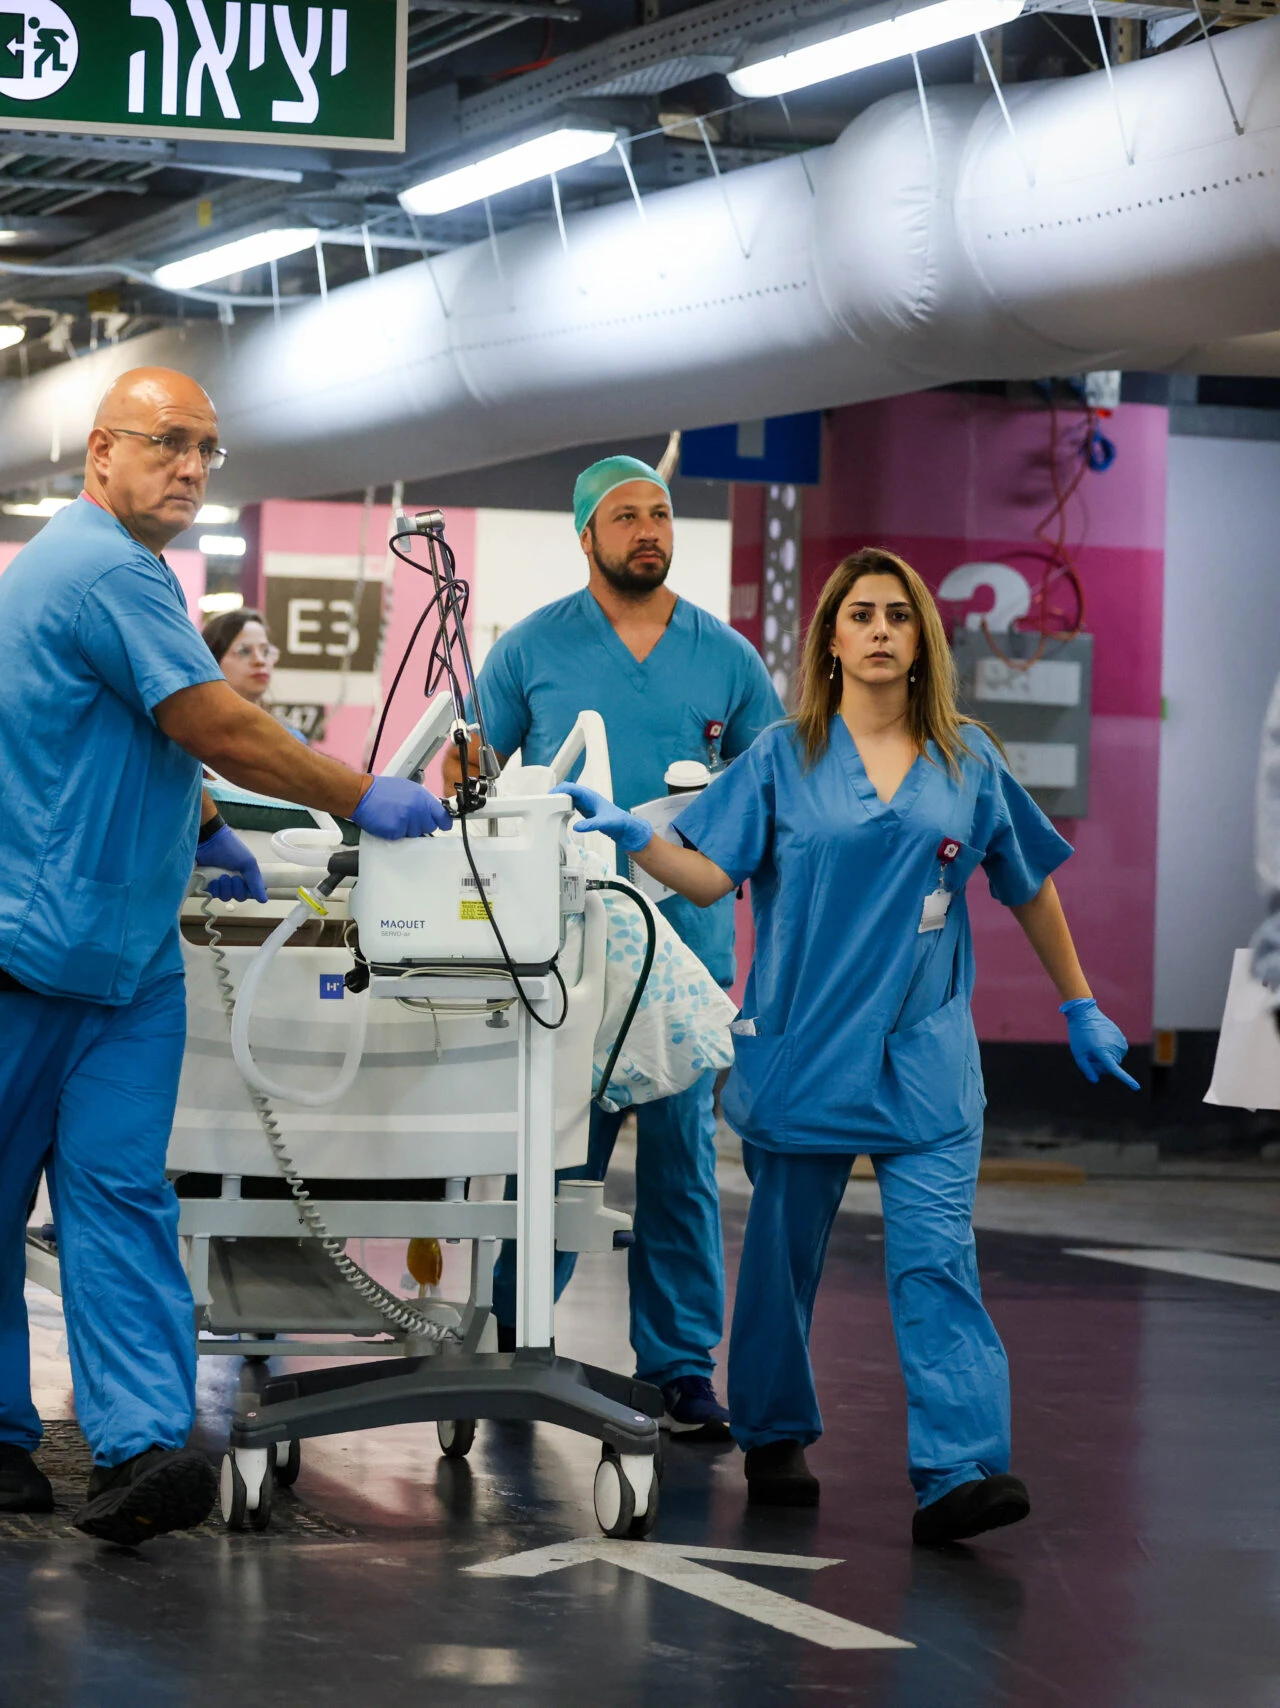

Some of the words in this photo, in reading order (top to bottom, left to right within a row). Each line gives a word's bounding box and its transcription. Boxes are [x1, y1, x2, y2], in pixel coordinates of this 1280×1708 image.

[128, 0, 348, 124] יציאה
[287, 598, 360, 657] E3
[380, 919, 426, 930] MAQUET
